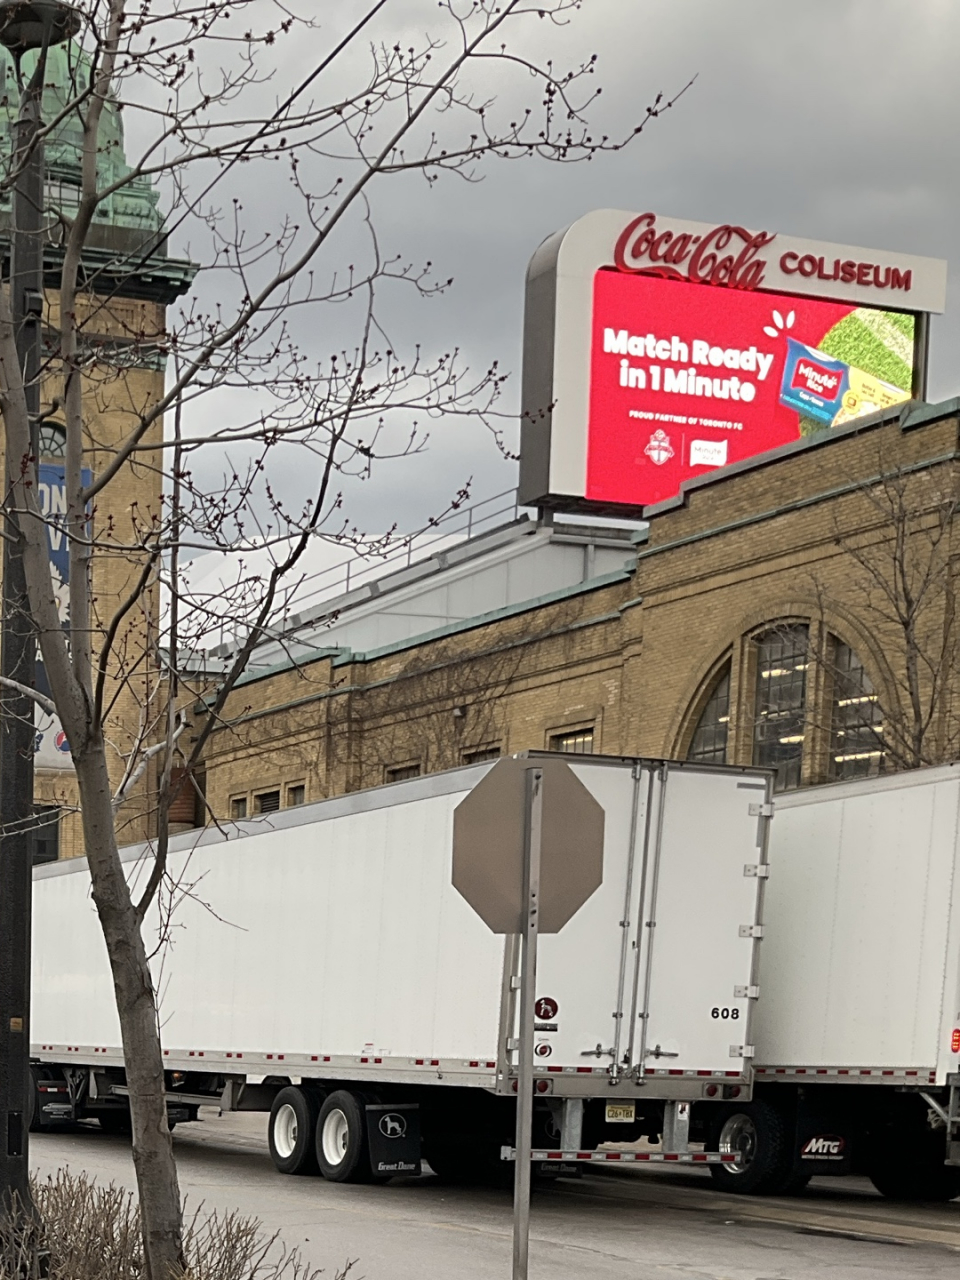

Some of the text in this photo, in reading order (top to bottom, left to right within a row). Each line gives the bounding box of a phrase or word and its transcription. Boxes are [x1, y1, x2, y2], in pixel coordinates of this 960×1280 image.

[614, 212, 912, 292] Coca-Cola COLISEUM
[603, 327, 774, 381] Match Ready
[619, 358, 756, 402] in 1 Minute
[798, 362, 838, 389] Minute
[806, 378, 823, 393] Rice
[629, 410, 743, 430] PROUD PARTNER OF TORONTO FC
[694, 446, 722, 455] Minute
[711, 1007, 740, 1020] 608
[804, 1138, 840, 1154] MTG
[378, 1161, 416, 1171] Great Dane
